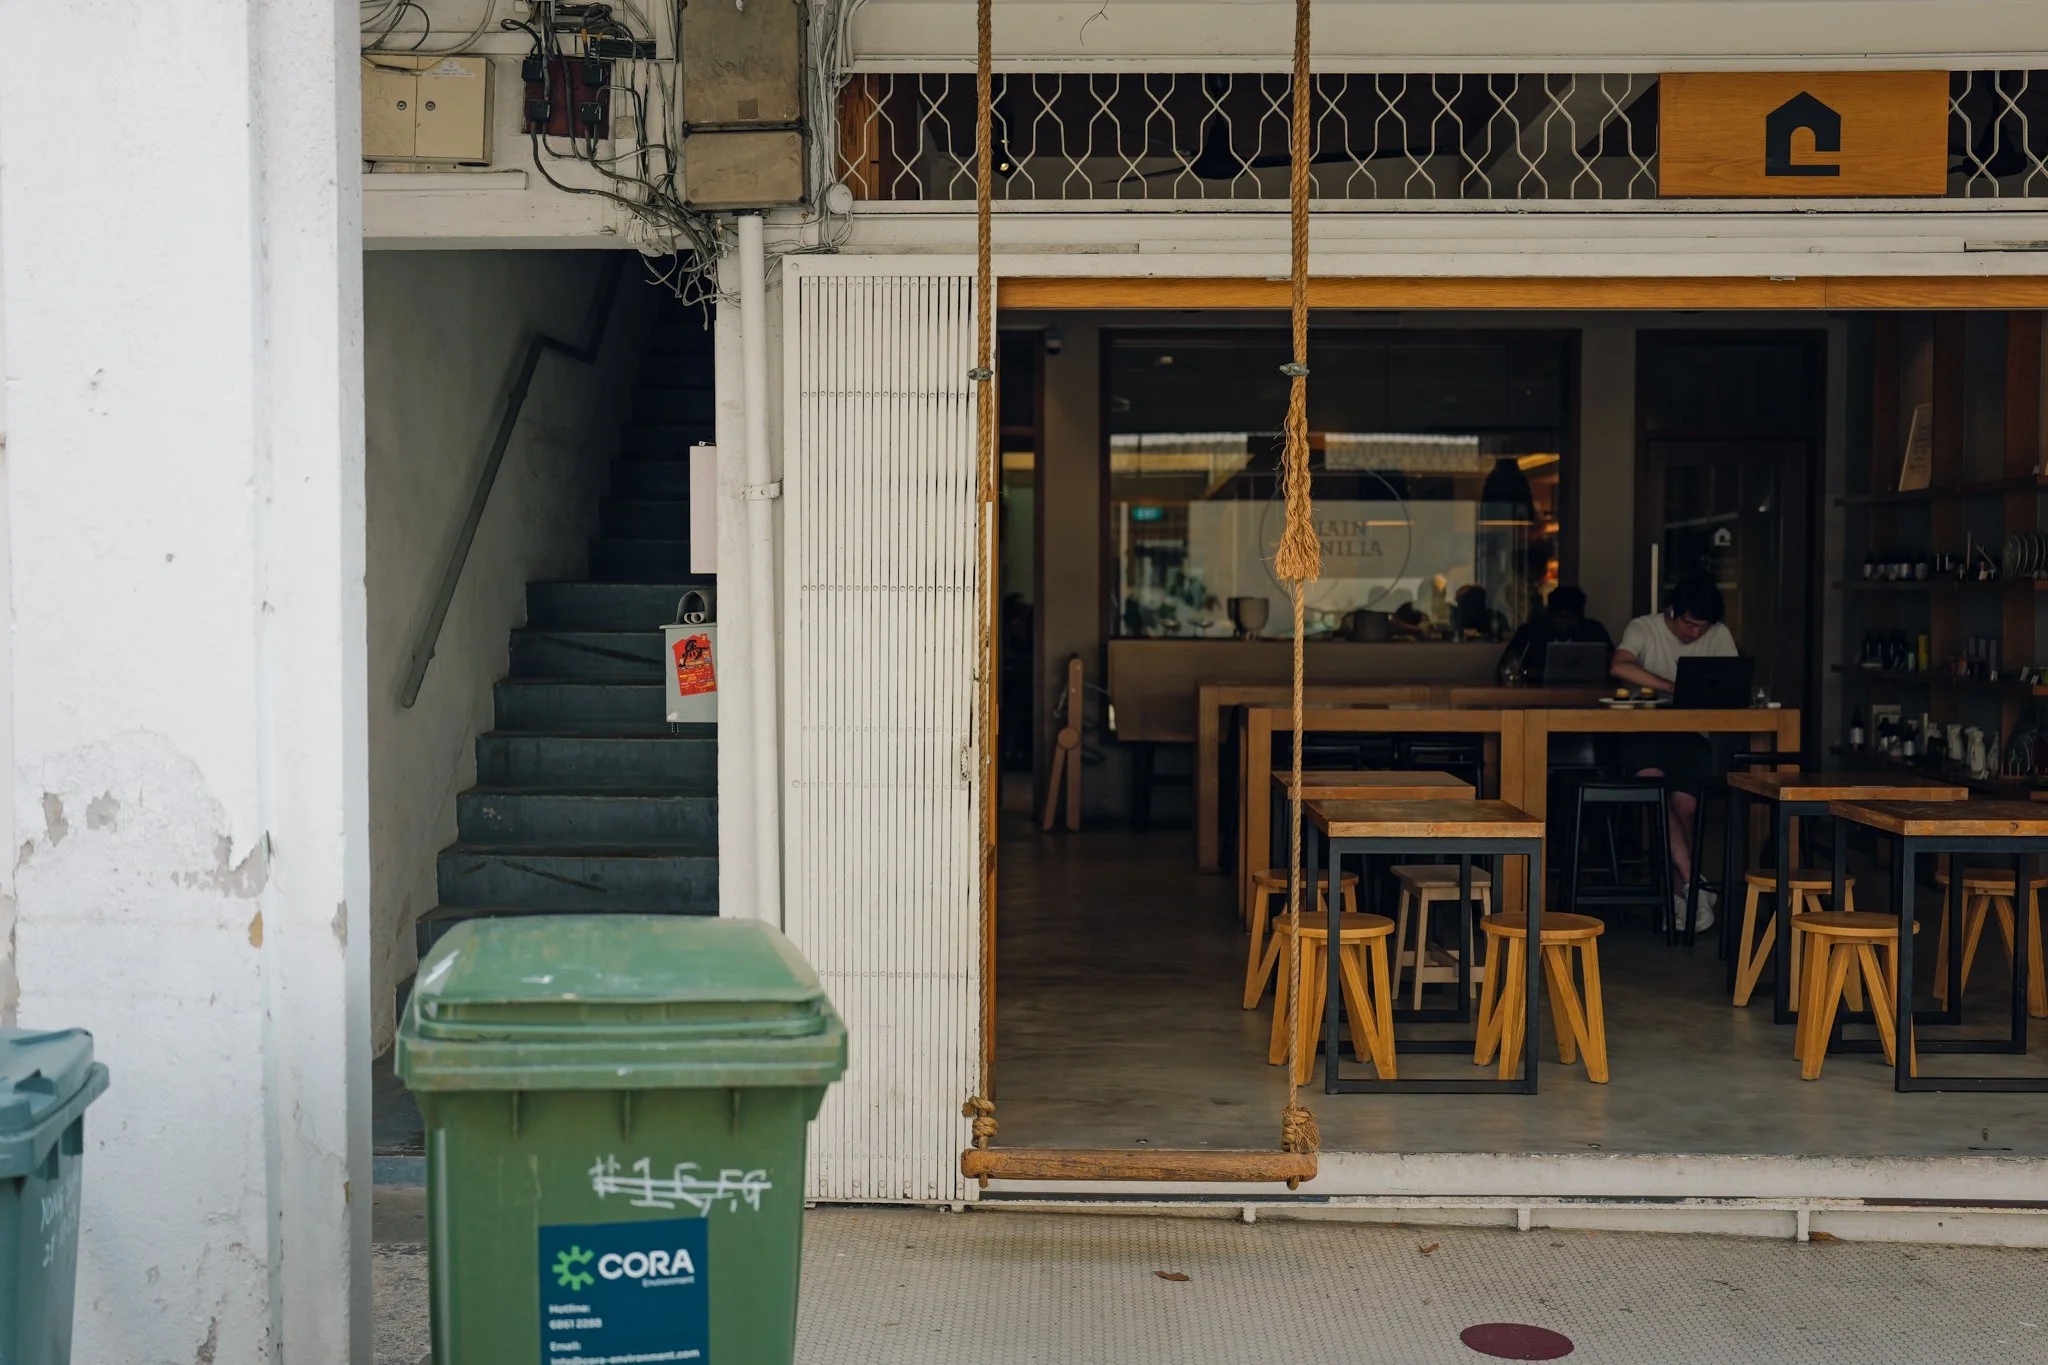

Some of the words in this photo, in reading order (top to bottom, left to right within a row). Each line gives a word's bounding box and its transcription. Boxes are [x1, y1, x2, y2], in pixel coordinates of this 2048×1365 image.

[1312, 519, 1368, 537] LAIN
[1319, 539, 1384, 557] NILLA
[598, 1249, 695, 1280] CORA
